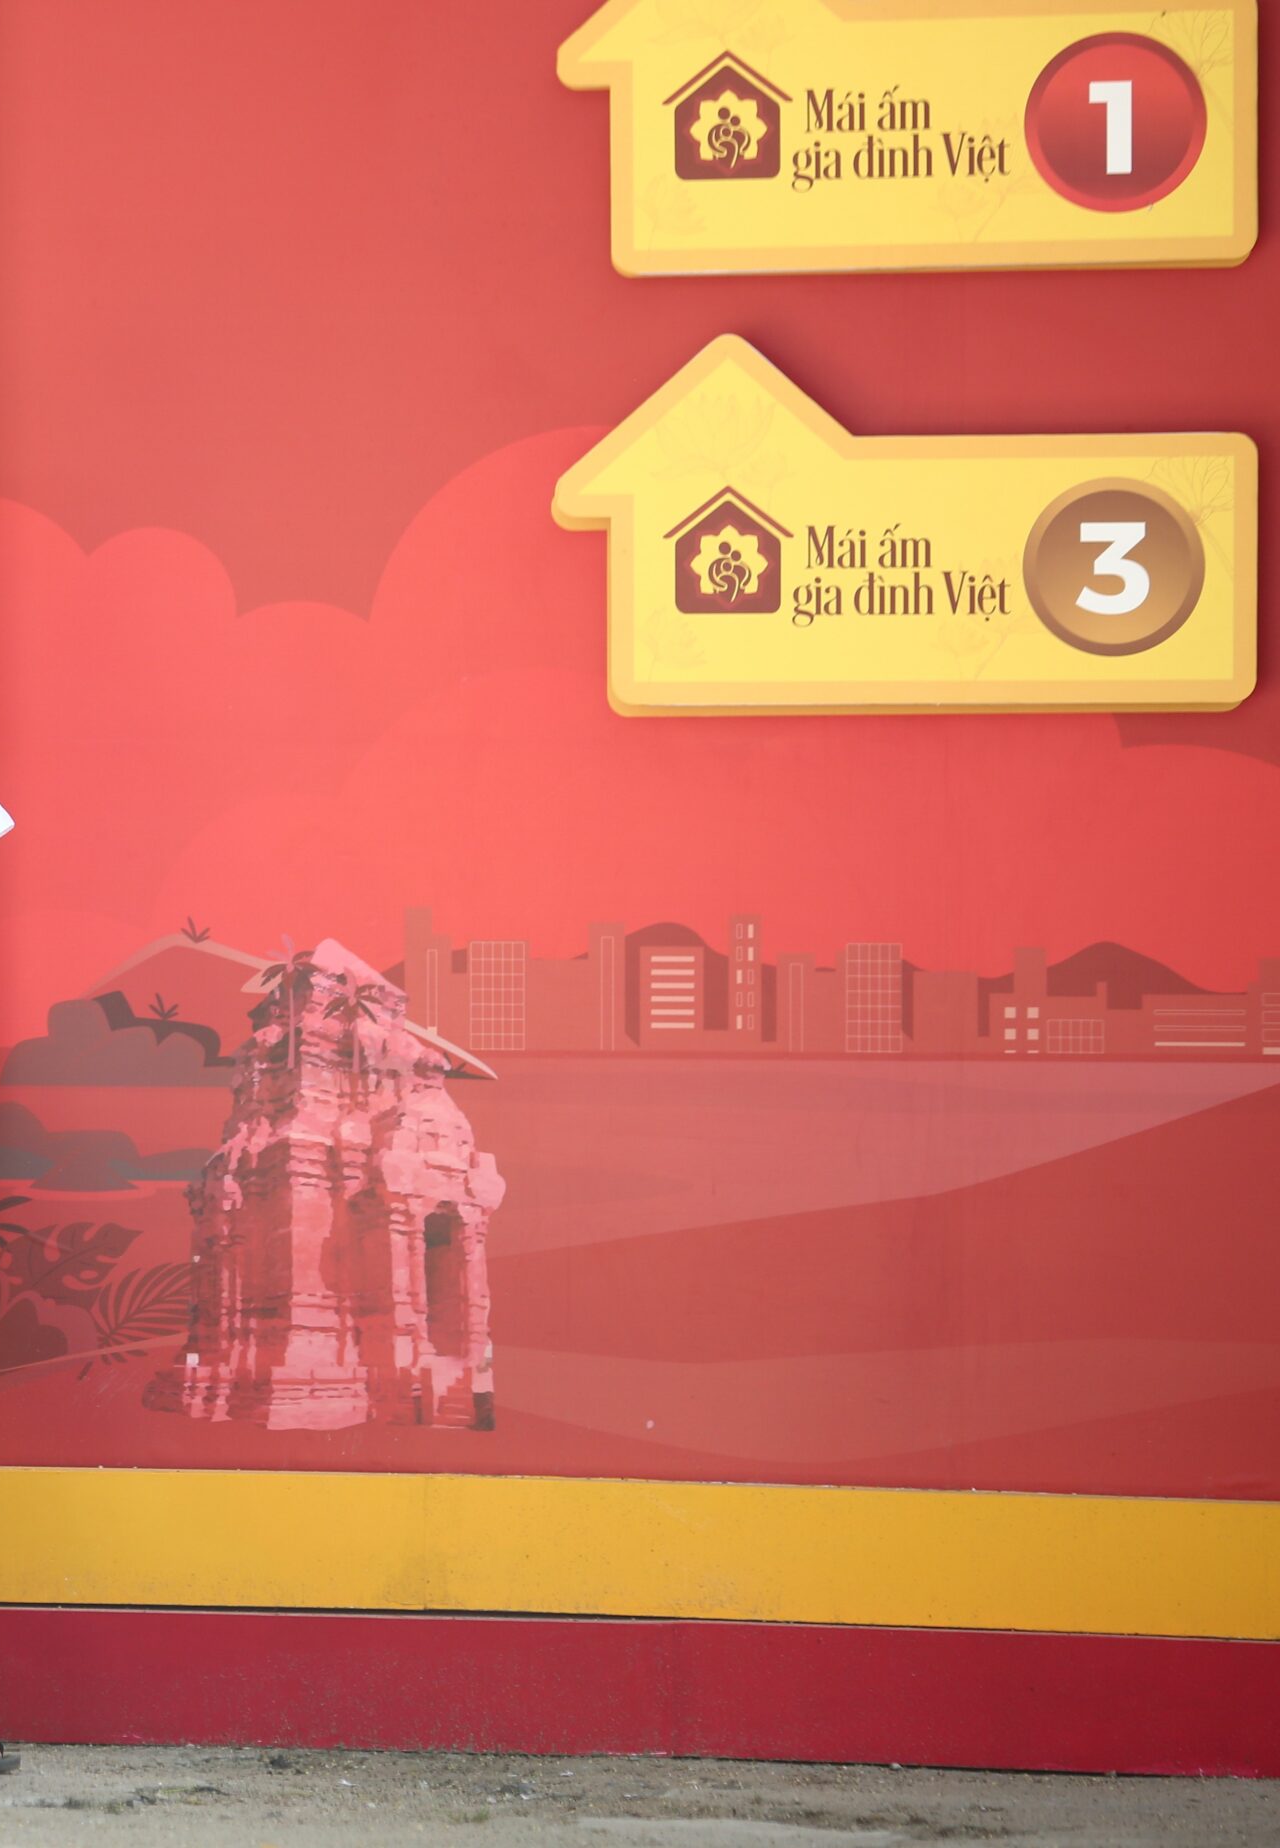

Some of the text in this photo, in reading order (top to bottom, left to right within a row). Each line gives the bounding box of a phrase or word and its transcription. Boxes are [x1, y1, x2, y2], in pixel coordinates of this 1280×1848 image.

[805, 84, 932, 133] Mái ấm
[1088, 80, 1134, 176] 1
[792, 131, 1011, 192] gia đình Việt
[805, 522, 933, 570] Mái ấm
[1075, 521, 1152, 616] 3
[792, 571, 1012, 628] gia đình Việt
